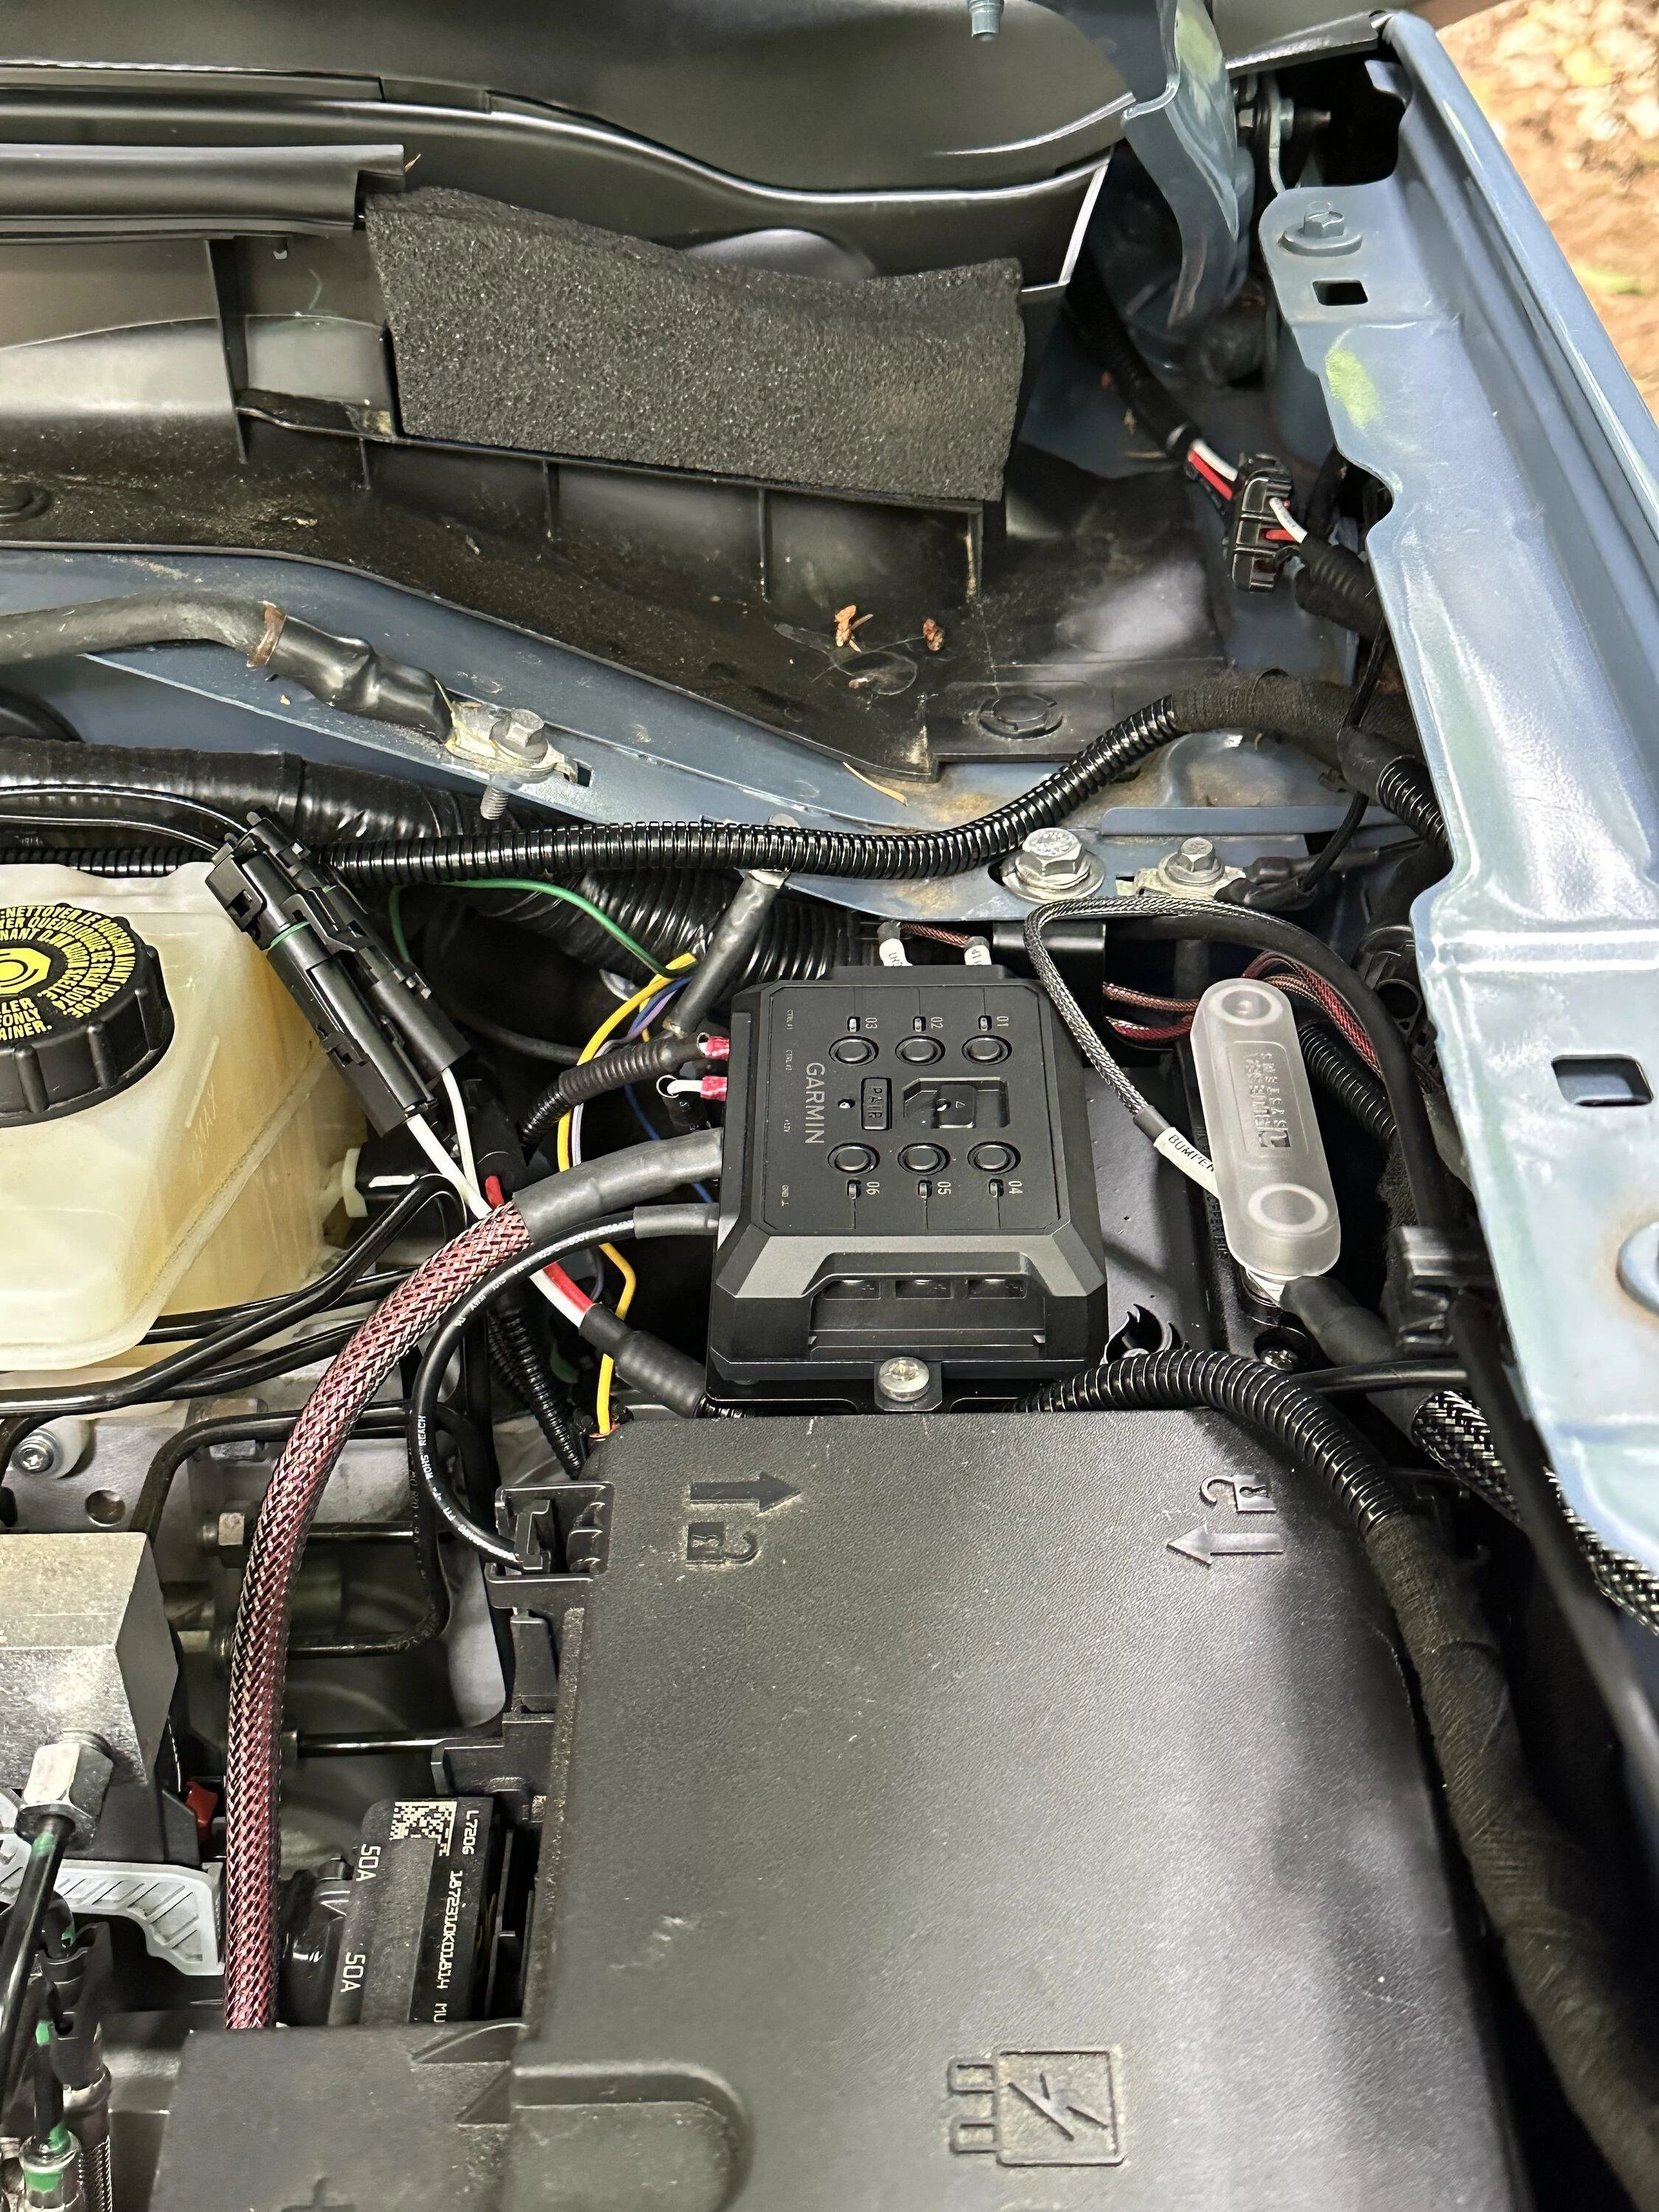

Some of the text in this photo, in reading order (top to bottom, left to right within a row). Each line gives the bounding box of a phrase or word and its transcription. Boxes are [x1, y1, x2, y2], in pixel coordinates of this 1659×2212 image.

[77, 912, 102, 925] LE
[866, 1017, 877, 1029] 03
[931, 1017, 943, 1029] 02
[997, 1016, 1009, 1029] 01
[804, 1061, 825, 1144] GARMIN
[868, 1088, 883, 1119] PAIR
[866, 1181, 880, 1195] 06
[938, 1181, 951, 1195] 05
[1009, 1180, 1022, 1194] 04
[417, 1415, 427, 1447] REACH
[420, 1454, 434, 1481] ROHS
[356, 1843, 381, 1882] 50A
[436, 1870, 464, 1989] 1872310K01814
[340, 1952, 366, 1993] 50A
